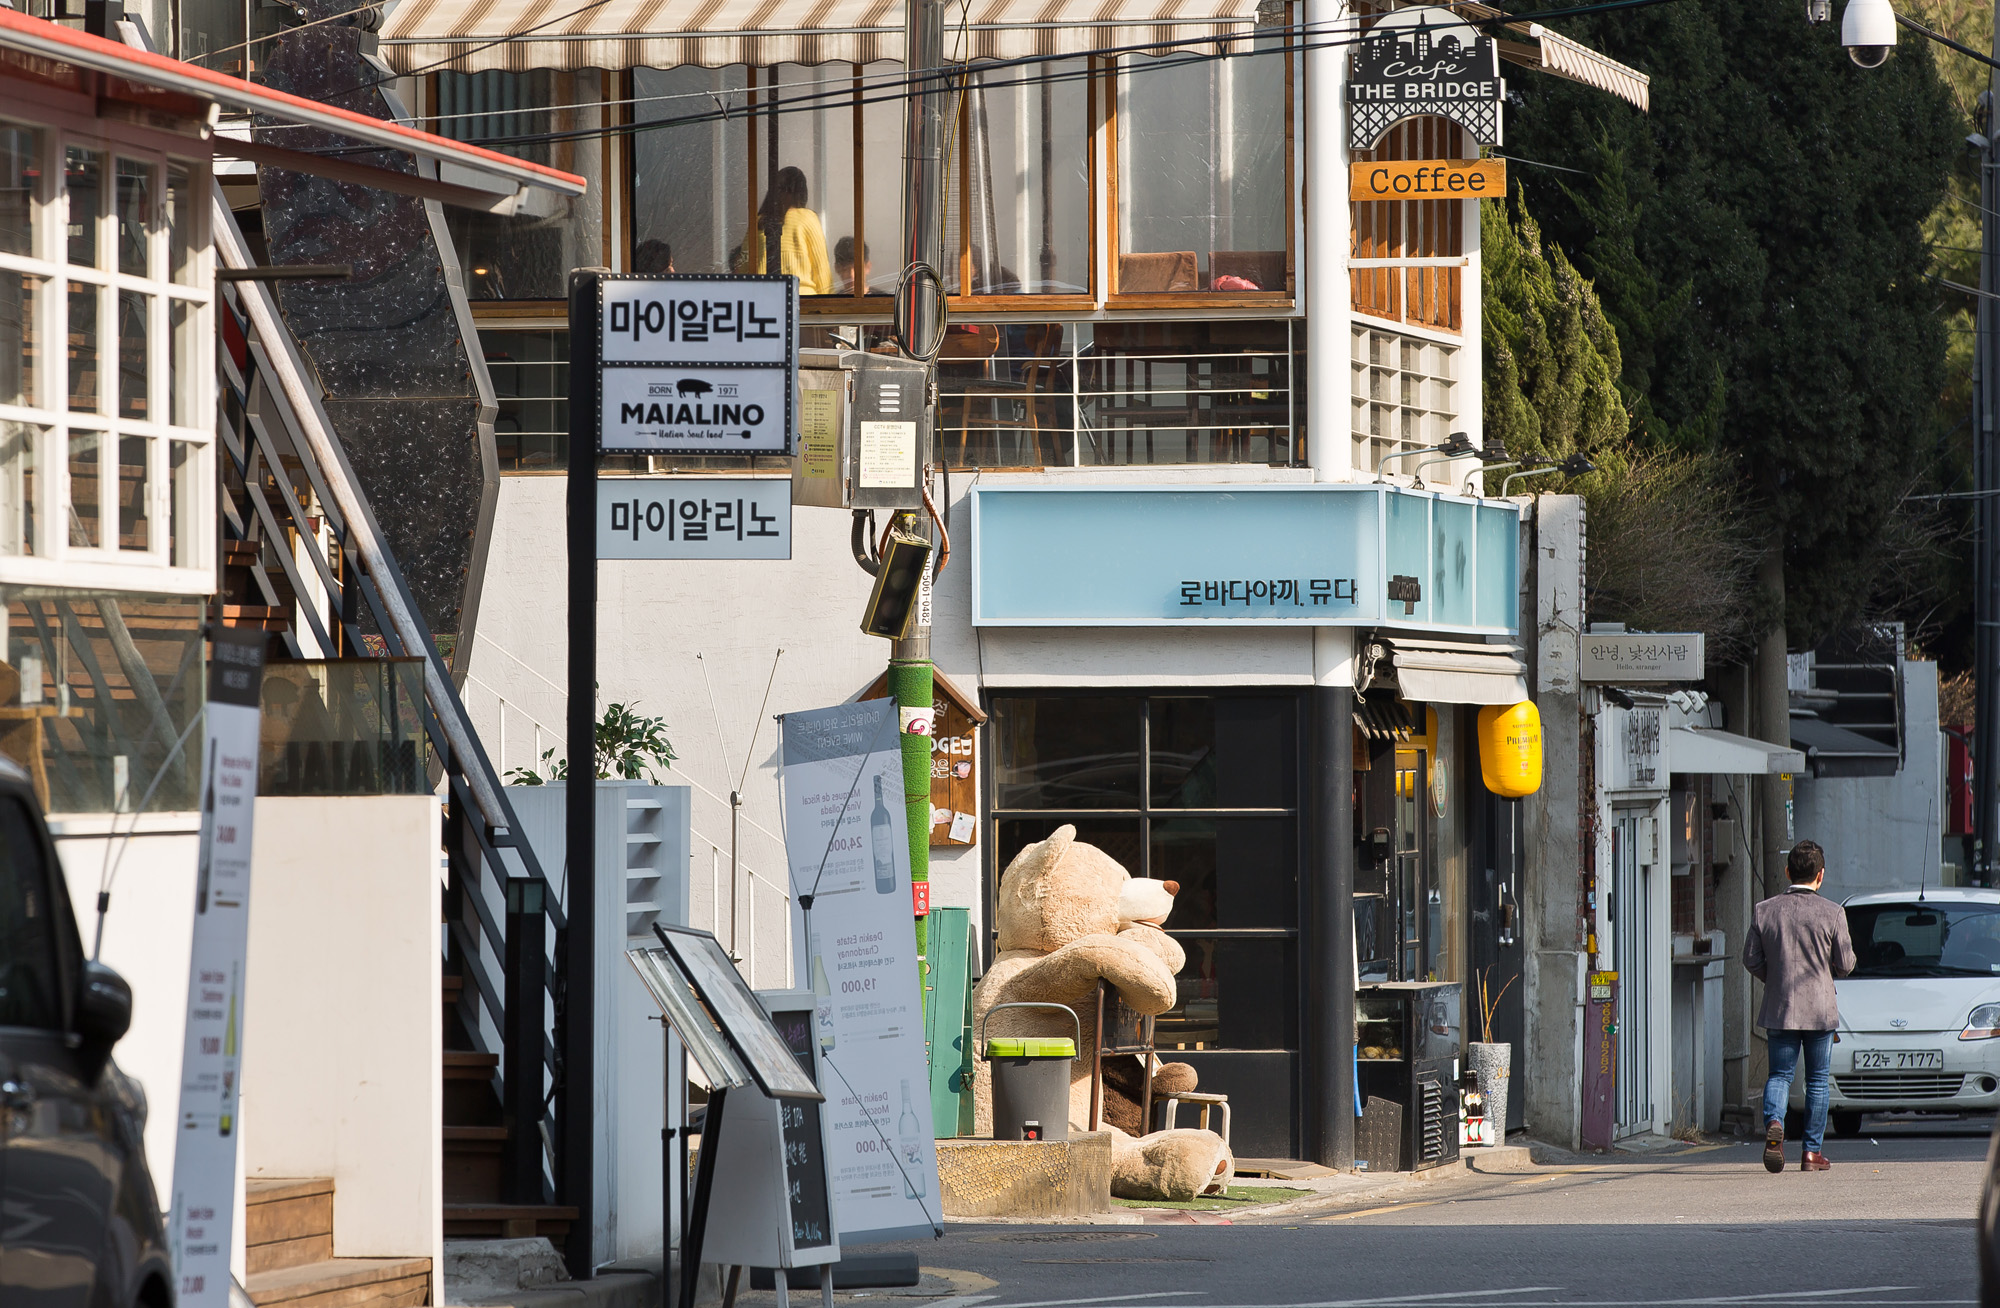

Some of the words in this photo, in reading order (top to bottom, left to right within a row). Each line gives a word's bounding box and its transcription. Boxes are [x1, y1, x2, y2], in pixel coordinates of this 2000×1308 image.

[1383, 60, 1467, 80] Cafe
[1350, 83, 1396, 99] THE
[1404, 81, 1493, 99] BRIDGE
[1370, 167, 1485, 194] Coffee
[610, 299, 780, 343] 마이알리노
[649, 386, 672, 394] BORN
[718, 387, 737, 395] 1971
[620, 403, 765, 426] MAIALINO
[659, 429, 685, 439] Italian
[687, 429, 705, 439] Soul
[611, 498, 779, 541] 마이알리노
[1309, 579, 1358, 605] 뮤다
[1590, 644, 1624, 662] 안녕,
[1628, 644, 1689, 661] 낯선사람
[1636, 664, 1661, 672] stranger
[1862, 1053, 1890, 1067] 22누
[1897, 1053, 1935, 1067] 7177
